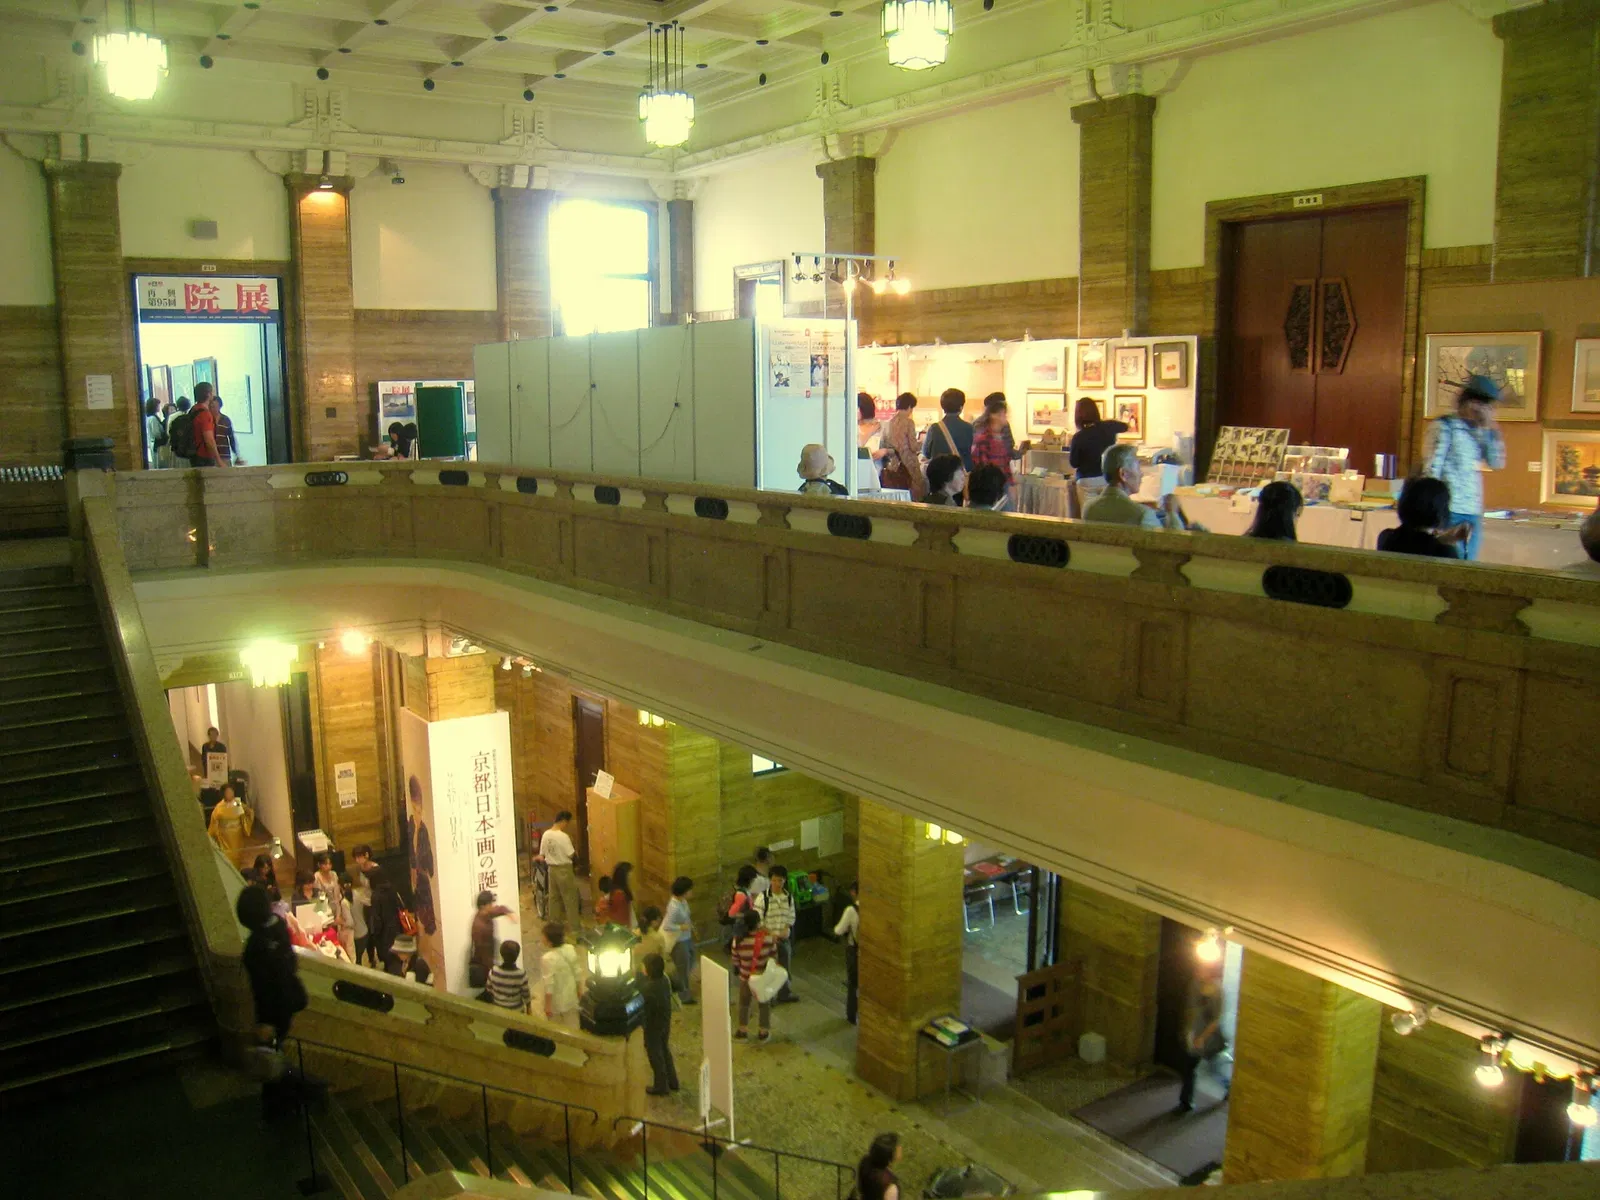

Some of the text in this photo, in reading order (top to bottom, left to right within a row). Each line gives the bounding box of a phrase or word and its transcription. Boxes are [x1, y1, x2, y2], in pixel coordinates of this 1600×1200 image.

[148, 298, 177, 307] 第95回
[184, 282, 271, 314] 院展
[471, 751, 499, 902] 京都日本画の誕
